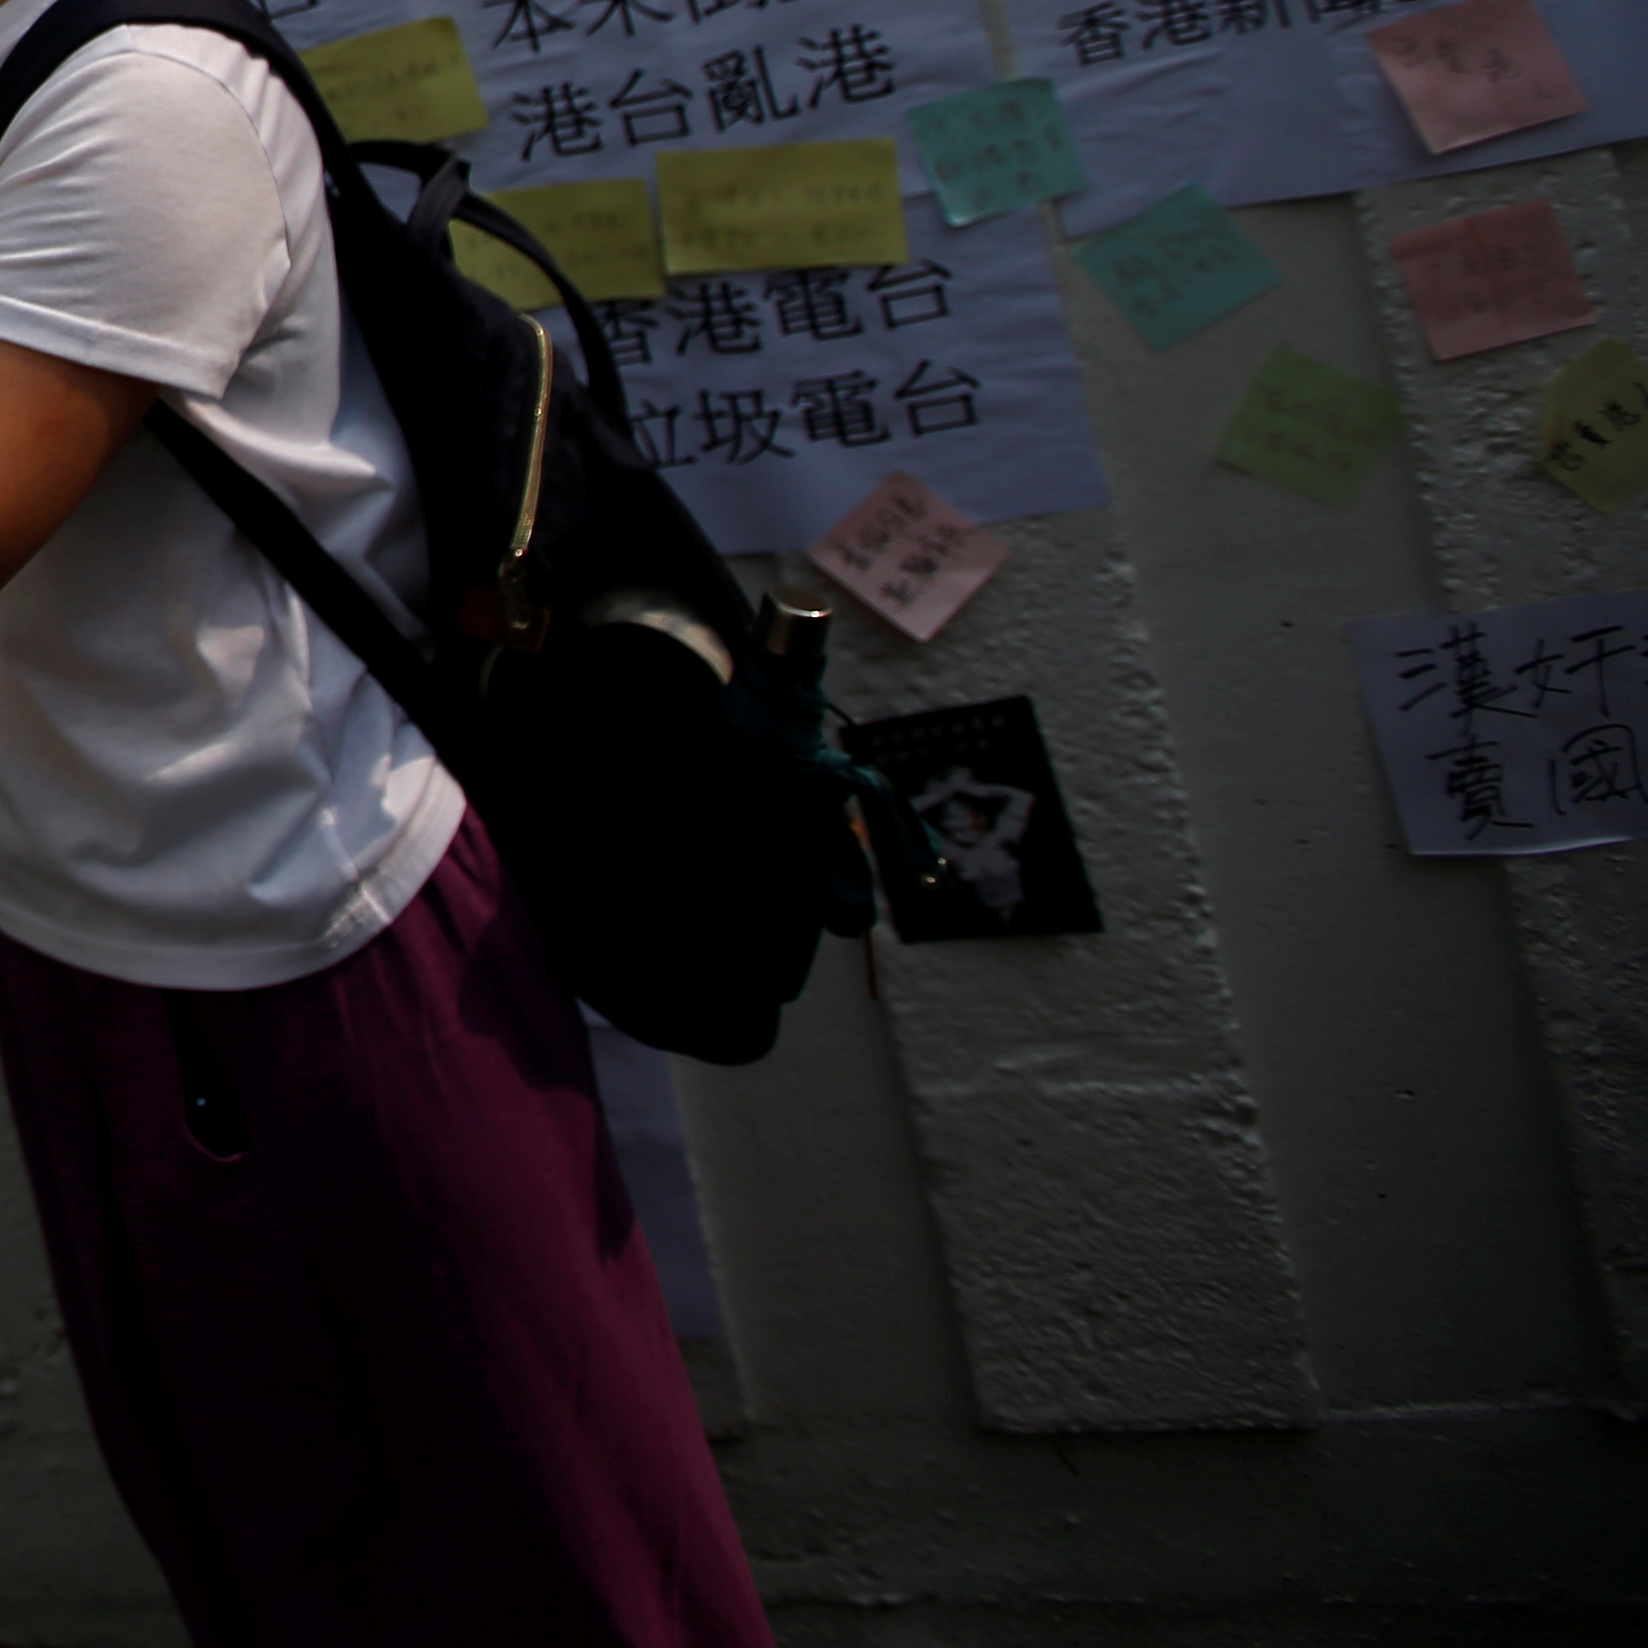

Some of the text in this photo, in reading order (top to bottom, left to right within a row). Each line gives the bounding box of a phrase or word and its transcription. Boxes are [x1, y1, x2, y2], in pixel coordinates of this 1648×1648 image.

[510, 24, 897, 163] 港台亂港
[593, 255, 953, 368] 香港電台
[1397, 621, 1648, 734] 漢奸
